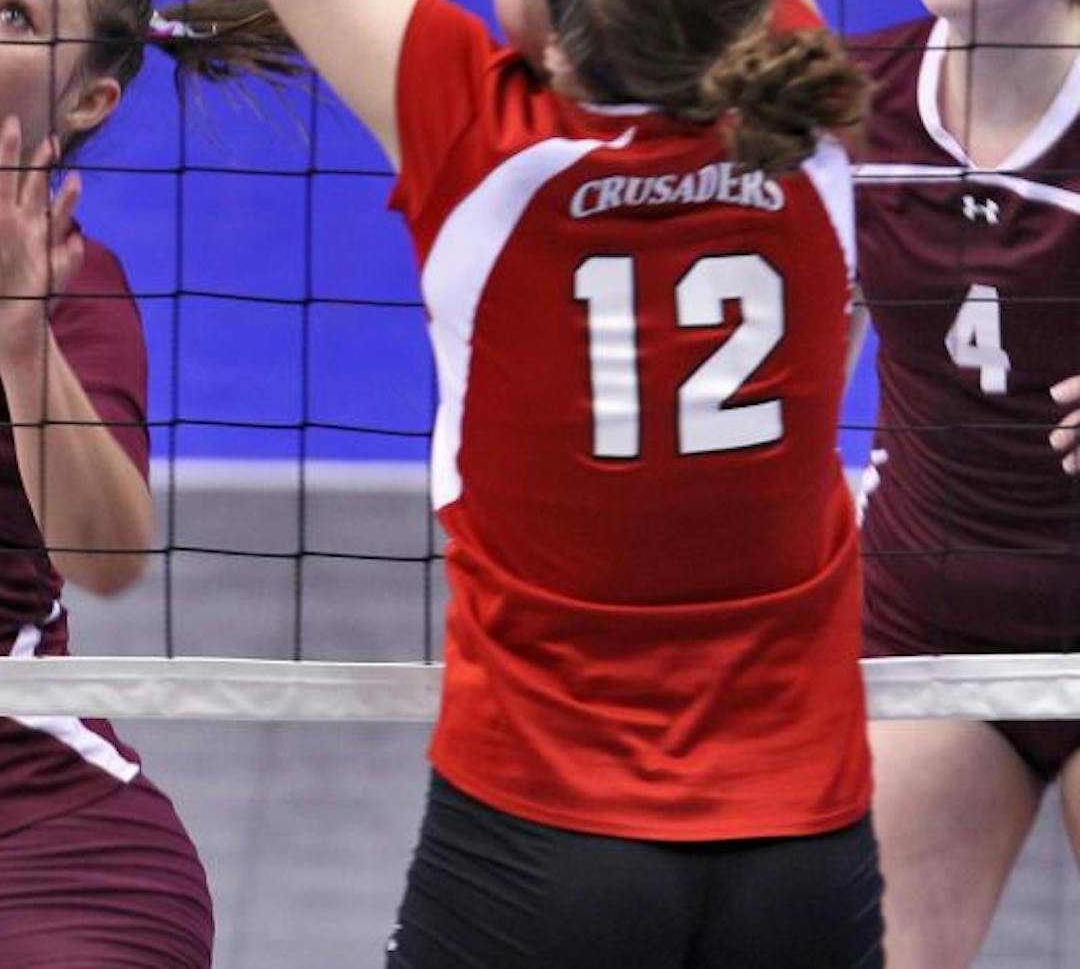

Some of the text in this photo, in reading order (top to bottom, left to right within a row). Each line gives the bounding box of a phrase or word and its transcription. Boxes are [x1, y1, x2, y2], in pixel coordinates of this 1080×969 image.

[571, 161, 785, 218] CRUSADERS
[572, 252, 786, 459] 12
[944, 283, 1011, 395] 4
